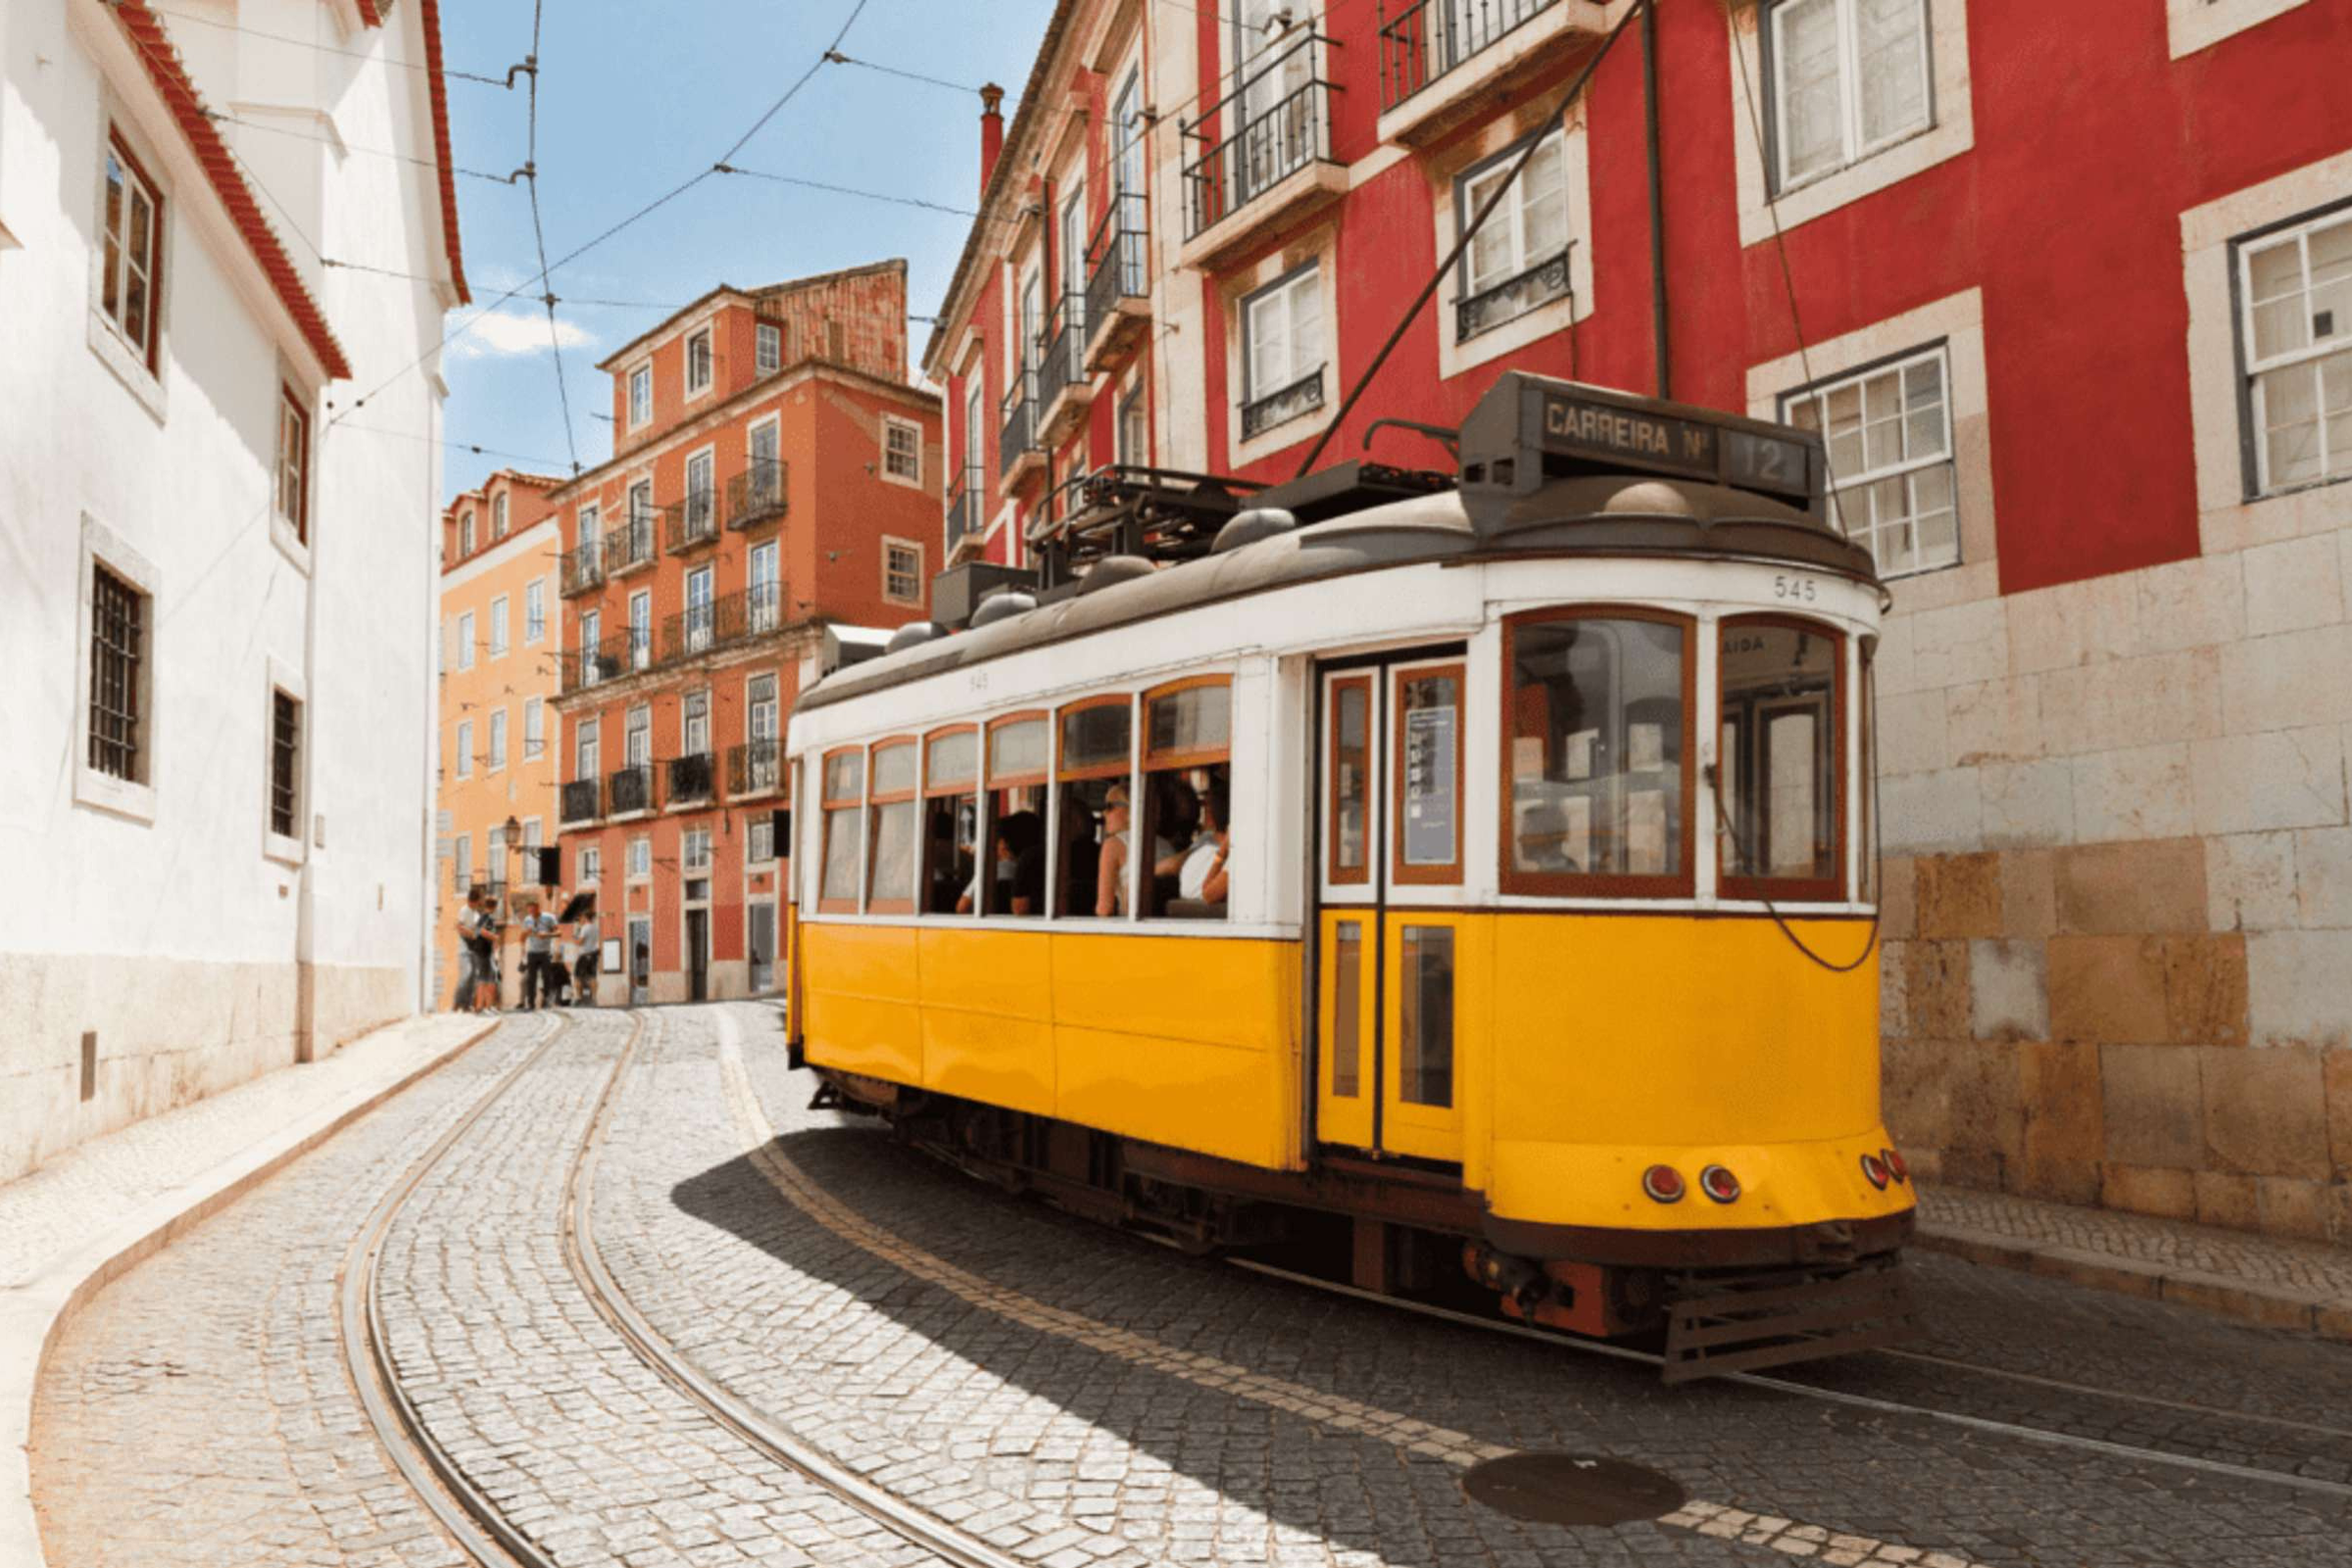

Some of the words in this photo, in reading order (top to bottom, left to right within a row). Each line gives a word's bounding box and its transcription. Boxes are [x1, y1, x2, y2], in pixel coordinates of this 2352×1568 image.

[1546, 403, 1669, 455] CARREIRA
[1743, 436, 1782, 479] 12
[1775, 575, 1817, 602] 545
